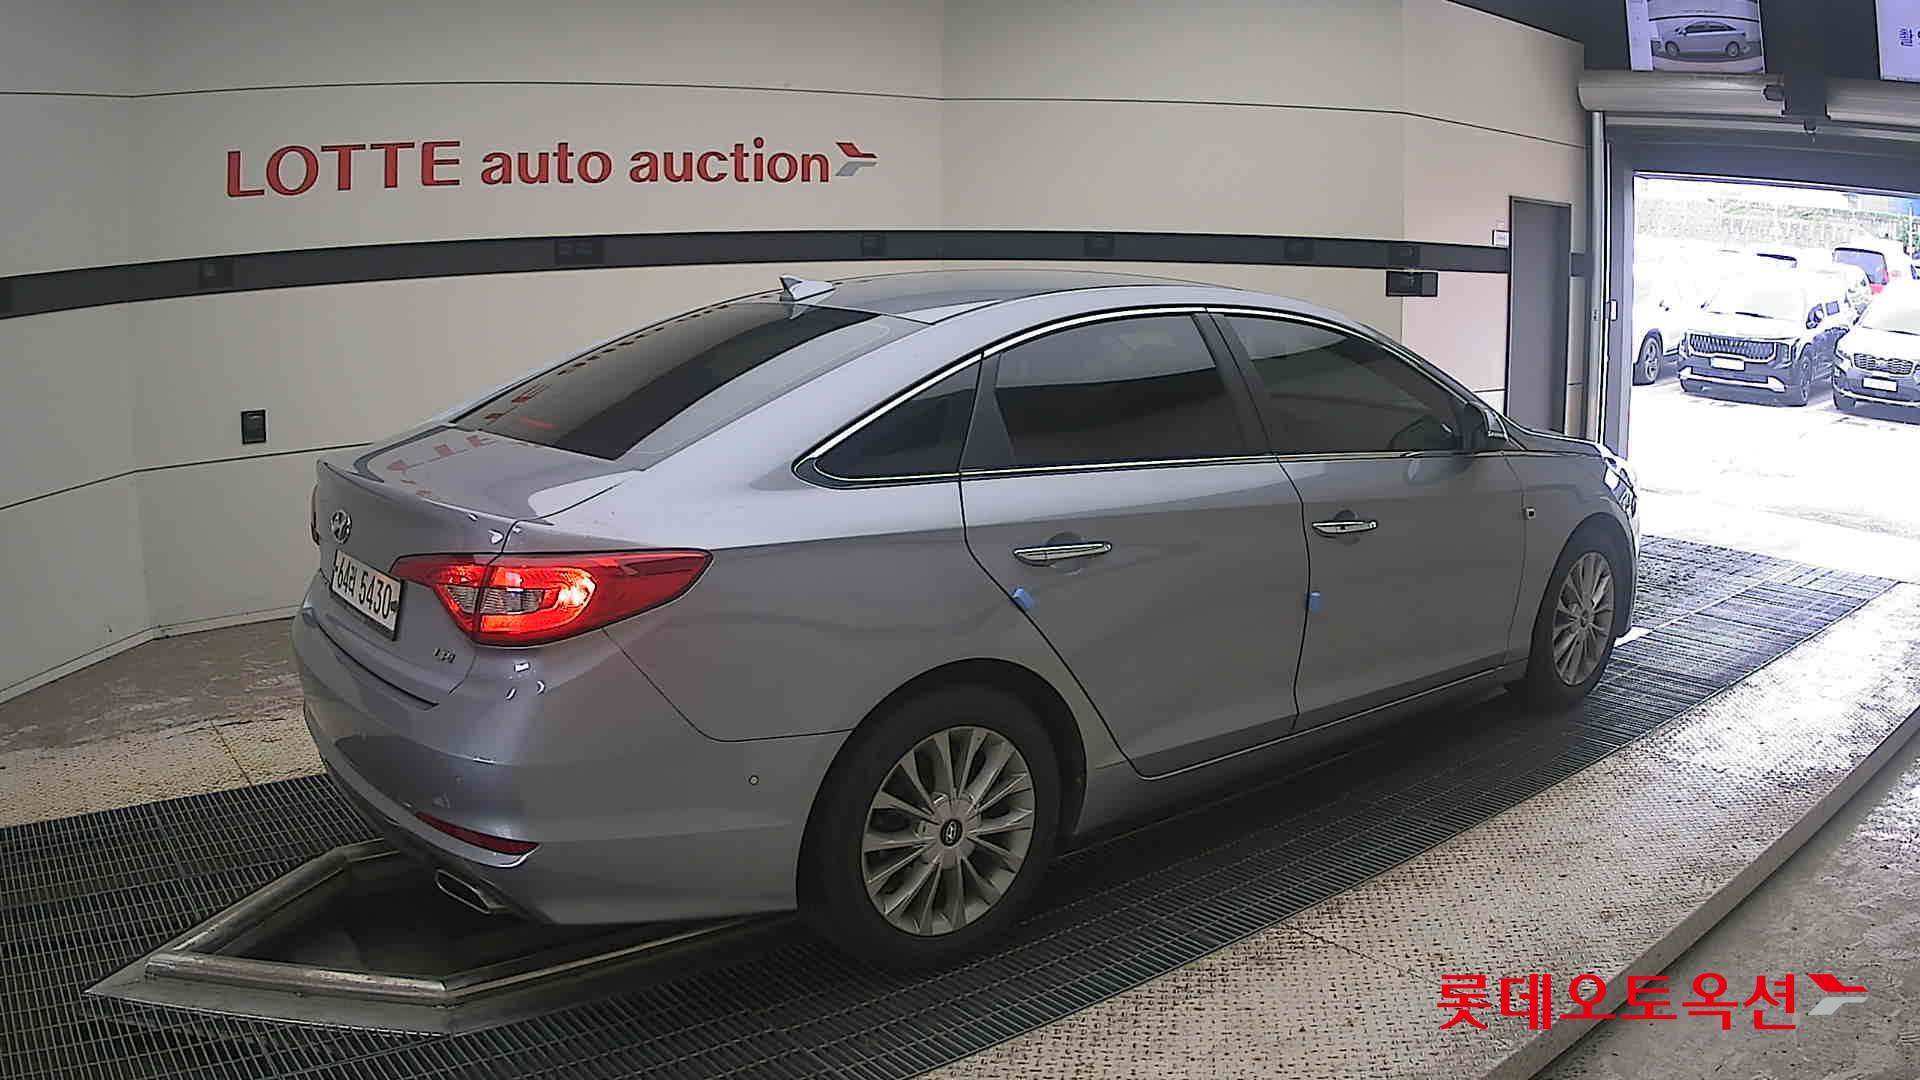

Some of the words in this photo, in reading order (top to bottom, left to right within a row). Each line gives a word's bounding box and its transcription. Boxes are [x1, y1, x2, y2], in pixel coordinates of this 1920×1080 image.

[226, 140, 461, 198] LOTTE
[480, 142, 612, 185] auto
[628, 137, 831, 184] auction
[359, 571, 392, 619] 5430
